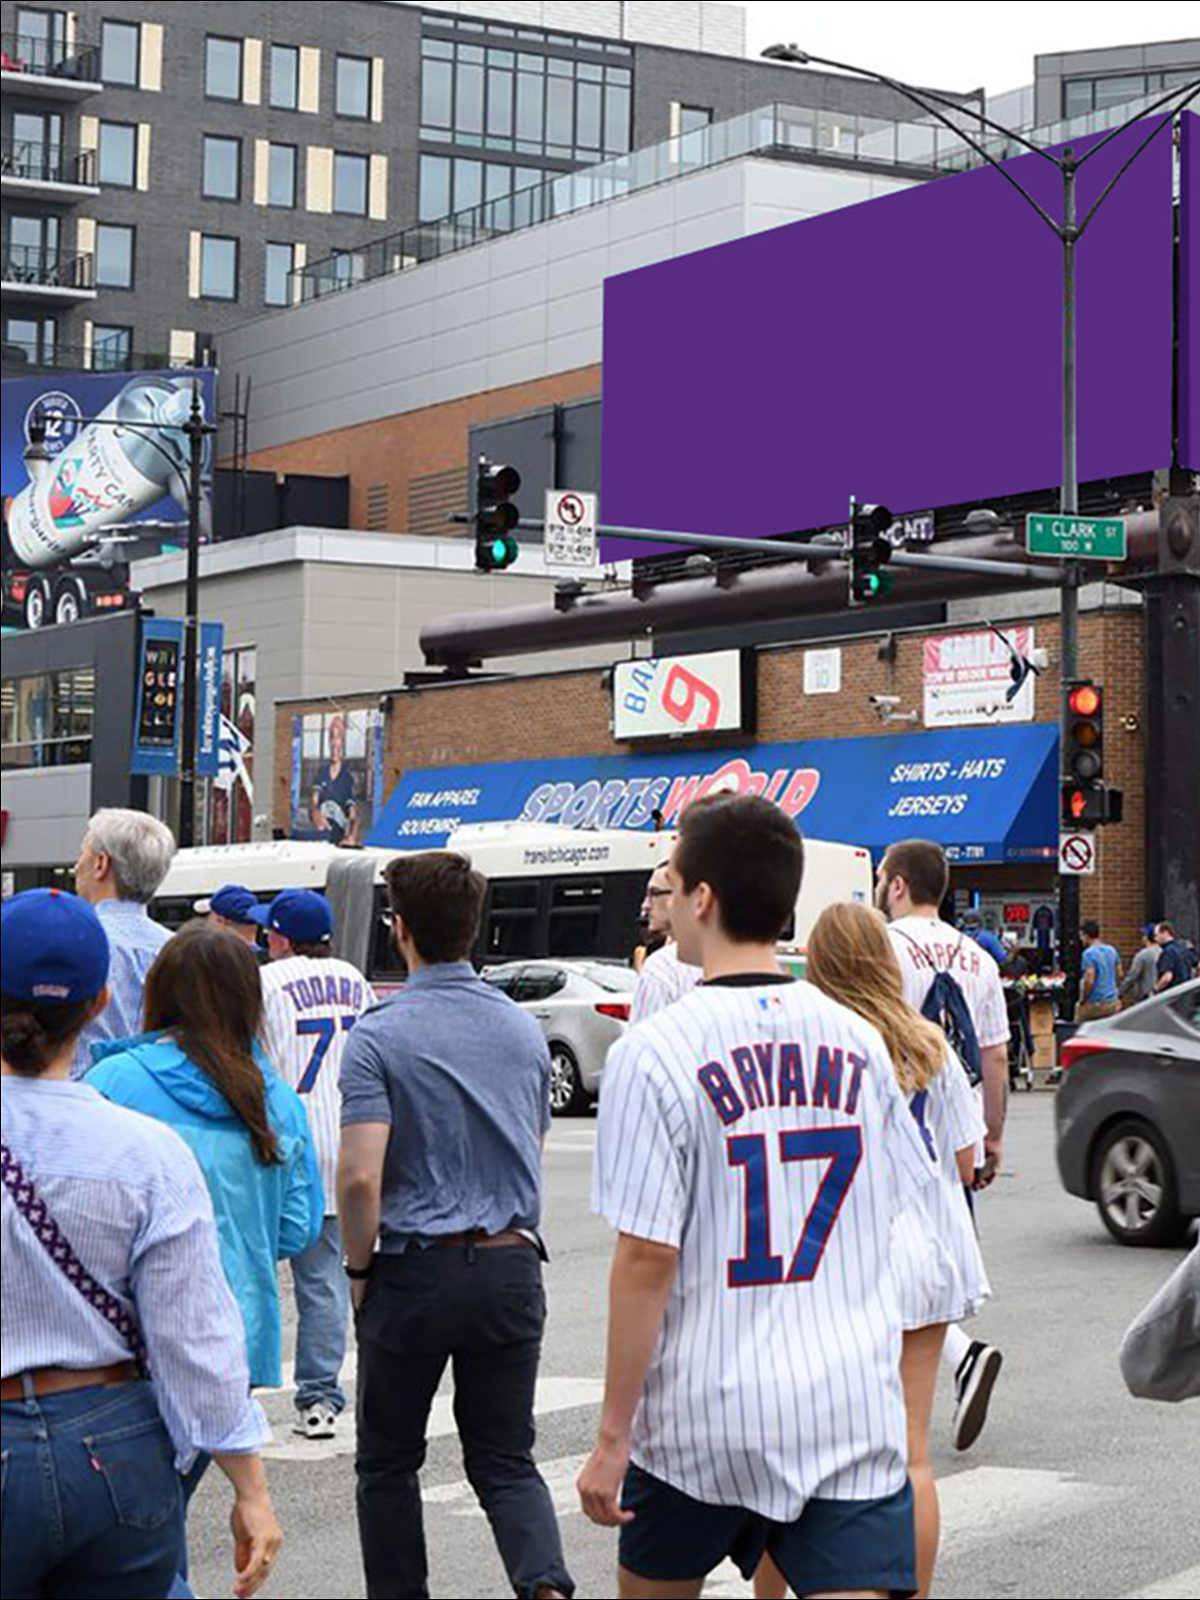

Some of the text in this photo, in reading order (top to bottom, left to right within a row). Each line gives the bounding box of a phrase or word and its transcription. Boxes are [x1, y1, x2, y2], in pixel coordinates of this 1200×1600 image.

[104, 483, 135, 509] CAN
[1052, 521, 1096, 538] CLARK
[1105, 526, 1117, 538] ST
[889, 761, 951, 784] SHIRTS
[957, 758, 1006, 780] HATS
[407, 787, 481, 809] FAN APPAREL
[887, 794, 968, 817] JERSEYS
[397, 816, 461, 836] SOUVENIRS
[523, 845, 610, 867] transitchicago.com
[907, 942, 980, 977] HARPER
[281, 975, 363, 1012] TODARO
[296, 1016, 356, 1094] 7
[698, 1043, 868, 1126] BRYANT
[727, 1125, 863, 1288] 17
